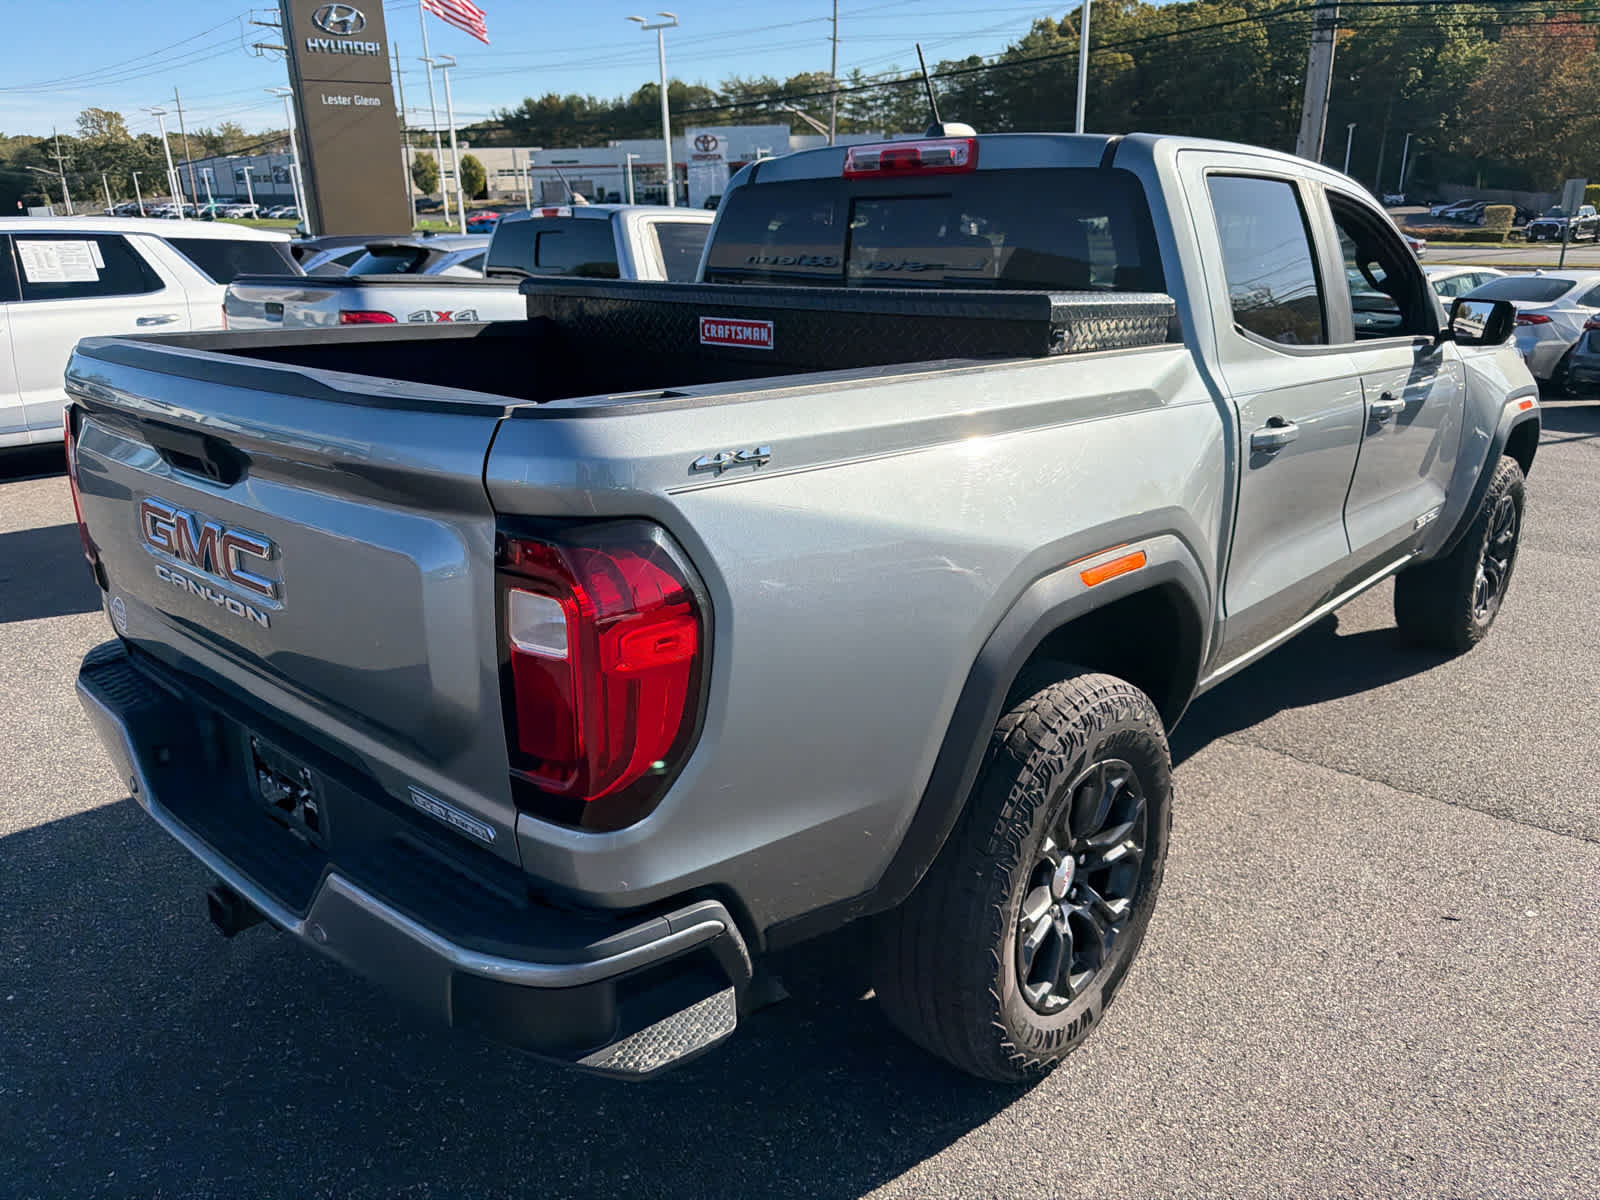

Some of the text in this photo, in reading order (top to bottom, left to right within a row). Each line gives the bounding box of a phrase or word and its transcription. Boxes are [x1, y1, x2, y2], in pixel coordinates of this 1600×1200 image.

[306, 38, 380, 56] HYUNDAI
[321, 94, 381, 106] Lester Glenn
[704, 323, 769, 342] CRAFTSMAN
[140, 497, 279, 600] GMC
[155, 564, 271, 629] CANYON
